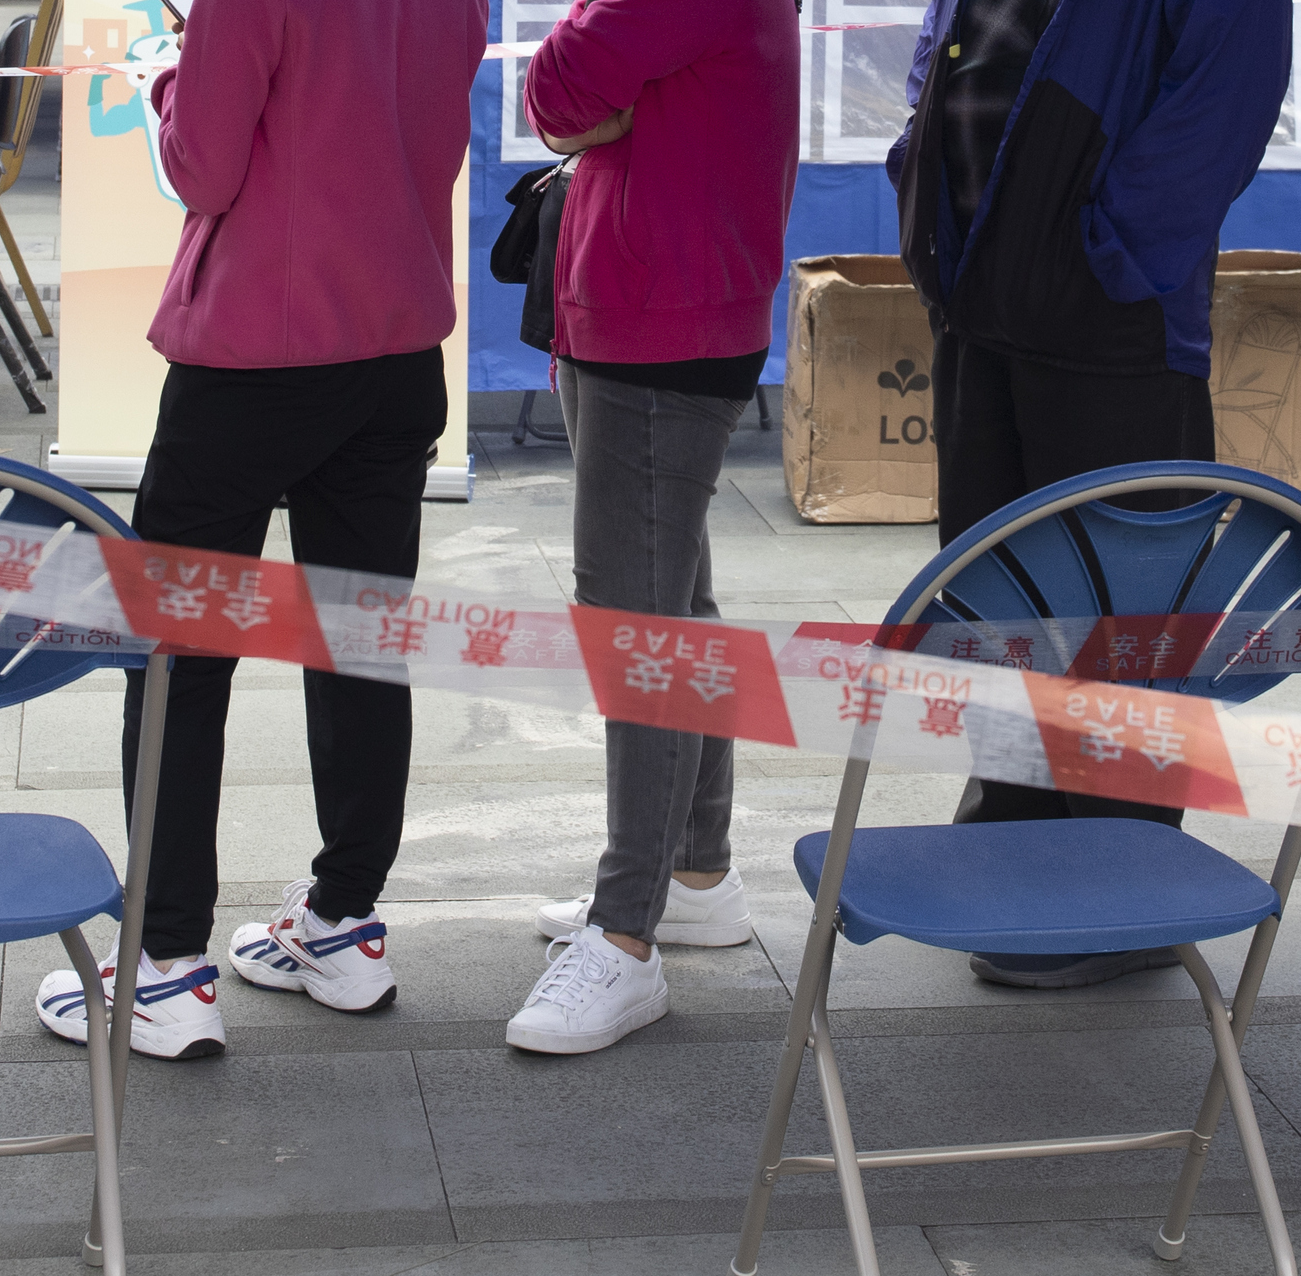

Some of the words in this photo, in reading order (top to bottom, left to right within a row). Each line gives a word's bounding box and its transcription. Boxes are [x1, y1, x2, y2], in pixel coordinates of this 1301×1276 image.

[880, 415, 937, 444] LO
[16, 632, 121, 646] CAUTION
[951, 636, 1034, 658] 注意
[1110, 632, 1177, 656] 安全
[1096, 655, 1167, 672] SAFE
